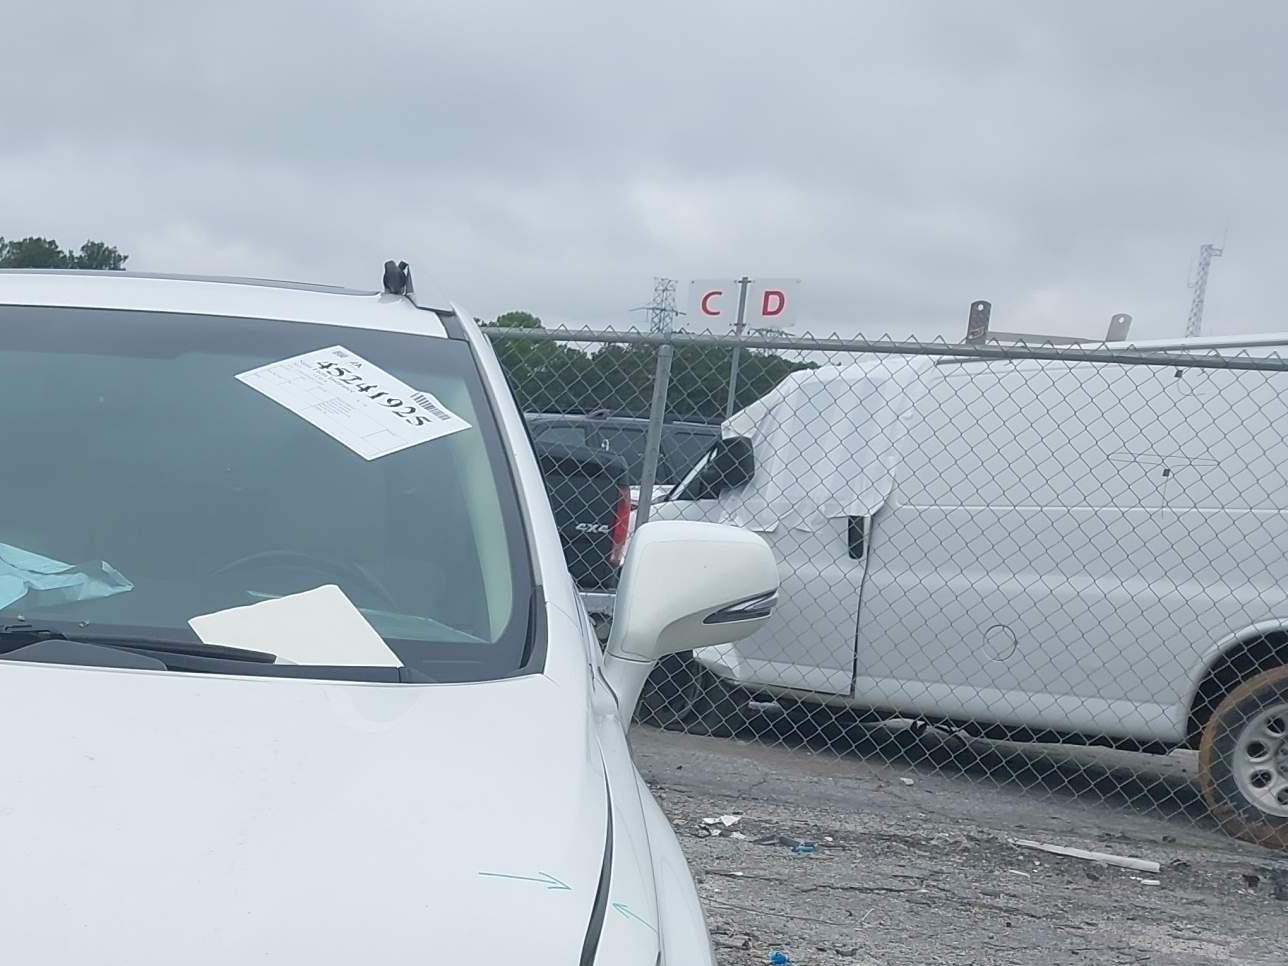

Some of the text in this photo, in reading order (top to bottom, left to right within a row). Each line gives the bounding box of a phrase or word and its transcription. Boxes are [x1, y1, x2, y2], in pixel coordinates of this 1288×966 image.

[700, 290, 723, 316] C
[761, 290, 786, 316] D
[316, 360, 432, 427] 45241925
